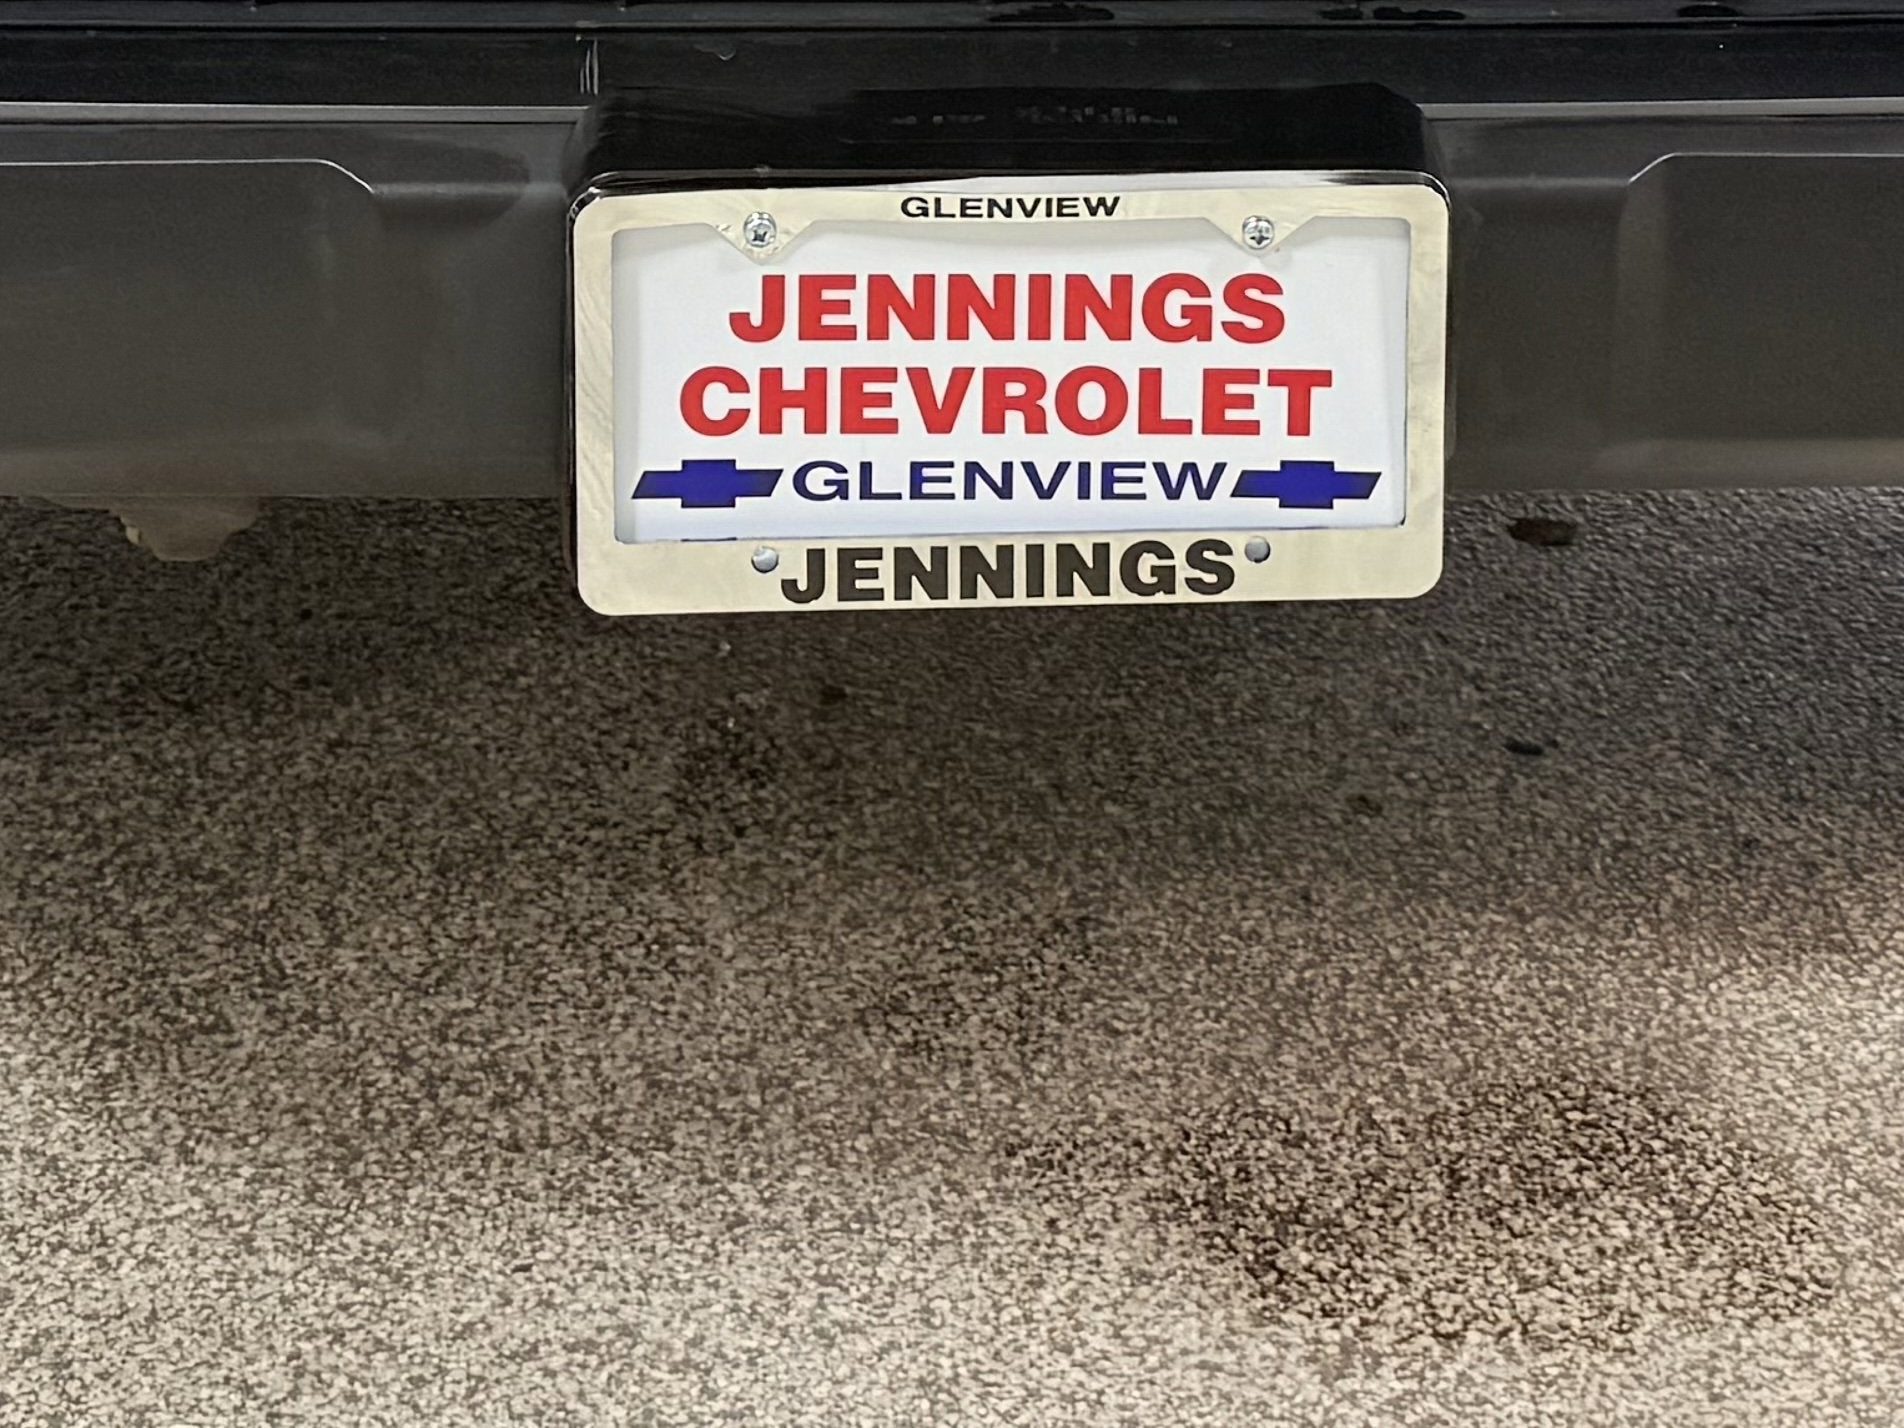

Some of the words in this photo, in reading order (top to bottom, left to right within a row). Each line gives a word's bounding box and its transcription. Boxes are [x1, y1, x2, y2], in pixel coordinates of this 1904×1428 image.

[900, 195, 1121, 219] GLENVIEW
[729, 273, 1285, 344] JENNINGS
[680, 366, 1333, 437] CHEVROLET
[792, 460, 1228, 502] GLENVIEW
[780, 538, 1236, 604] JENNINGS
